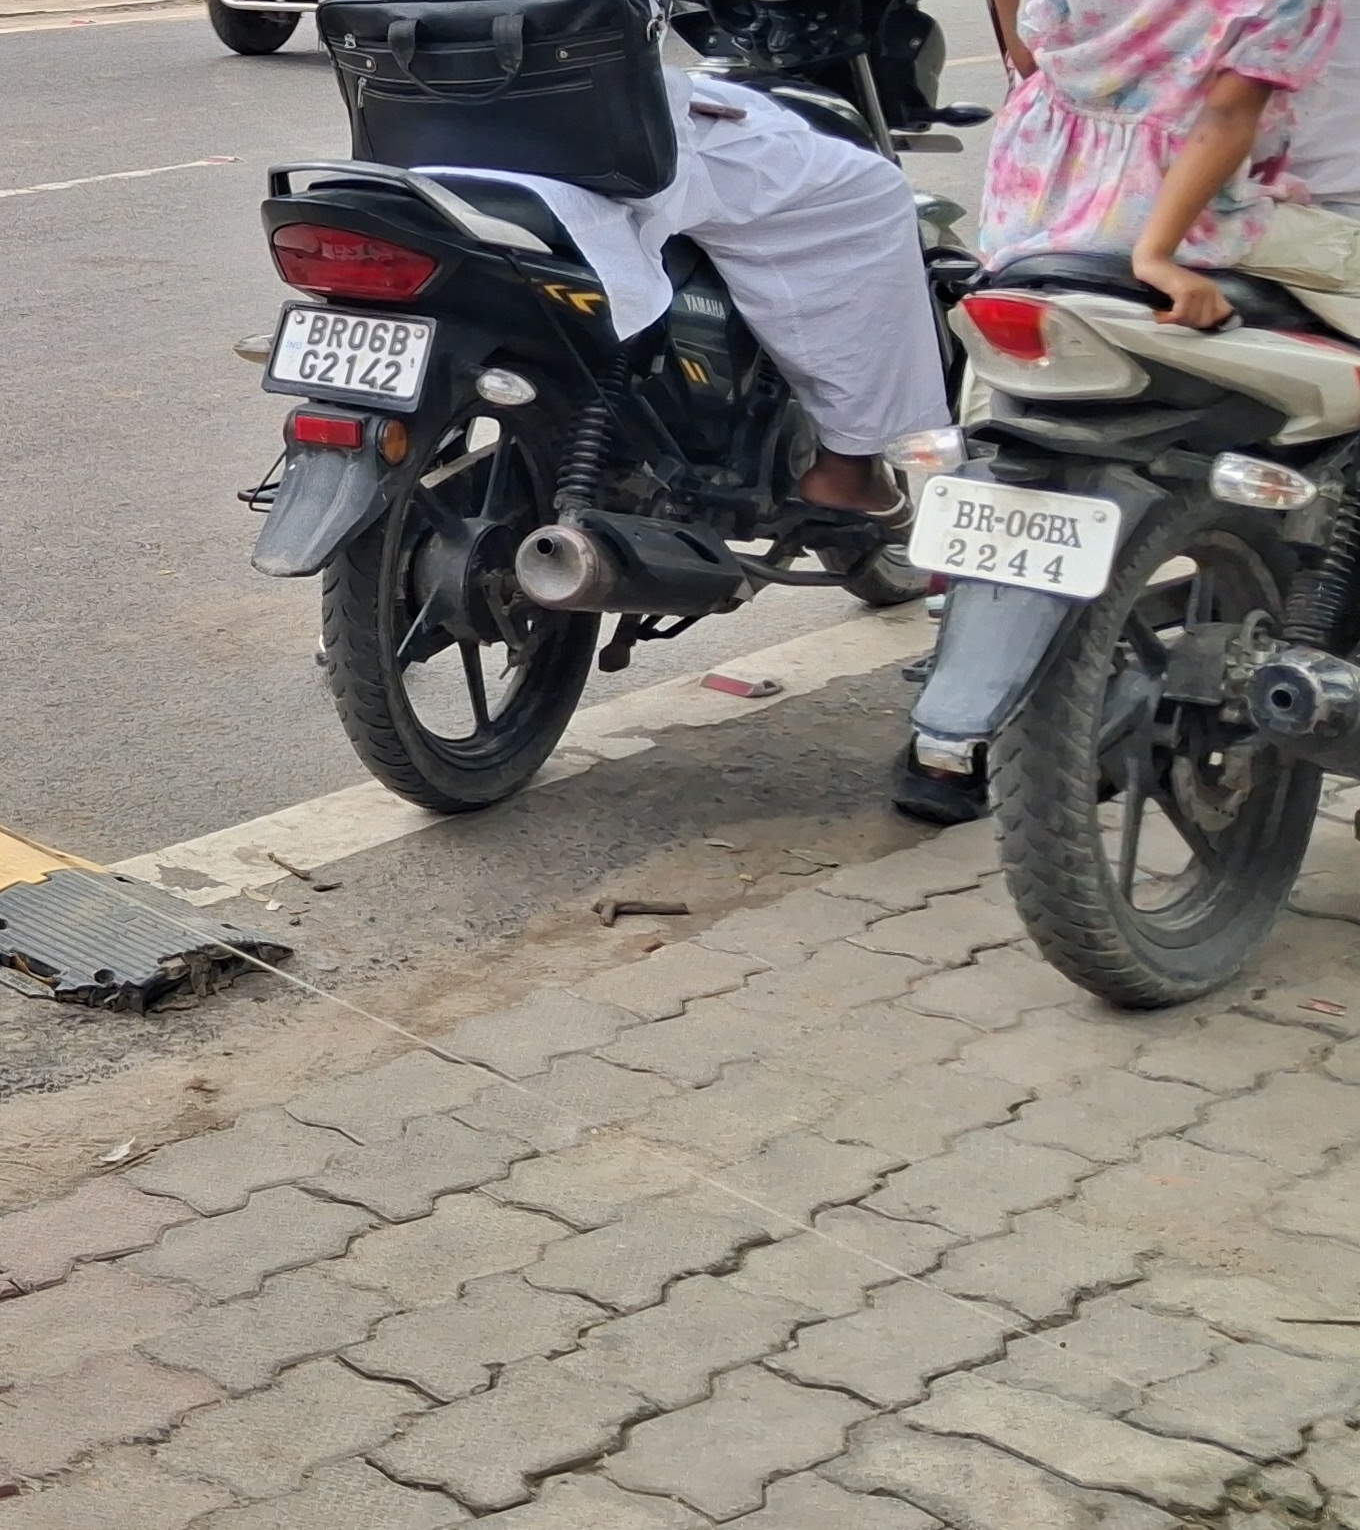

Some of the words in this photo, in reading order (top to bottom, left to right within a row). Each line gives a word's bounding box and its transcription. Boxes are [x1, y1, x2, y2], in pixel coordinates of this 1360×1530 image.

[683, 293, 726, 320] YAMAHA
[306, 314, 411, 357] BR06B
[299, 349, 402, 392] G2142
